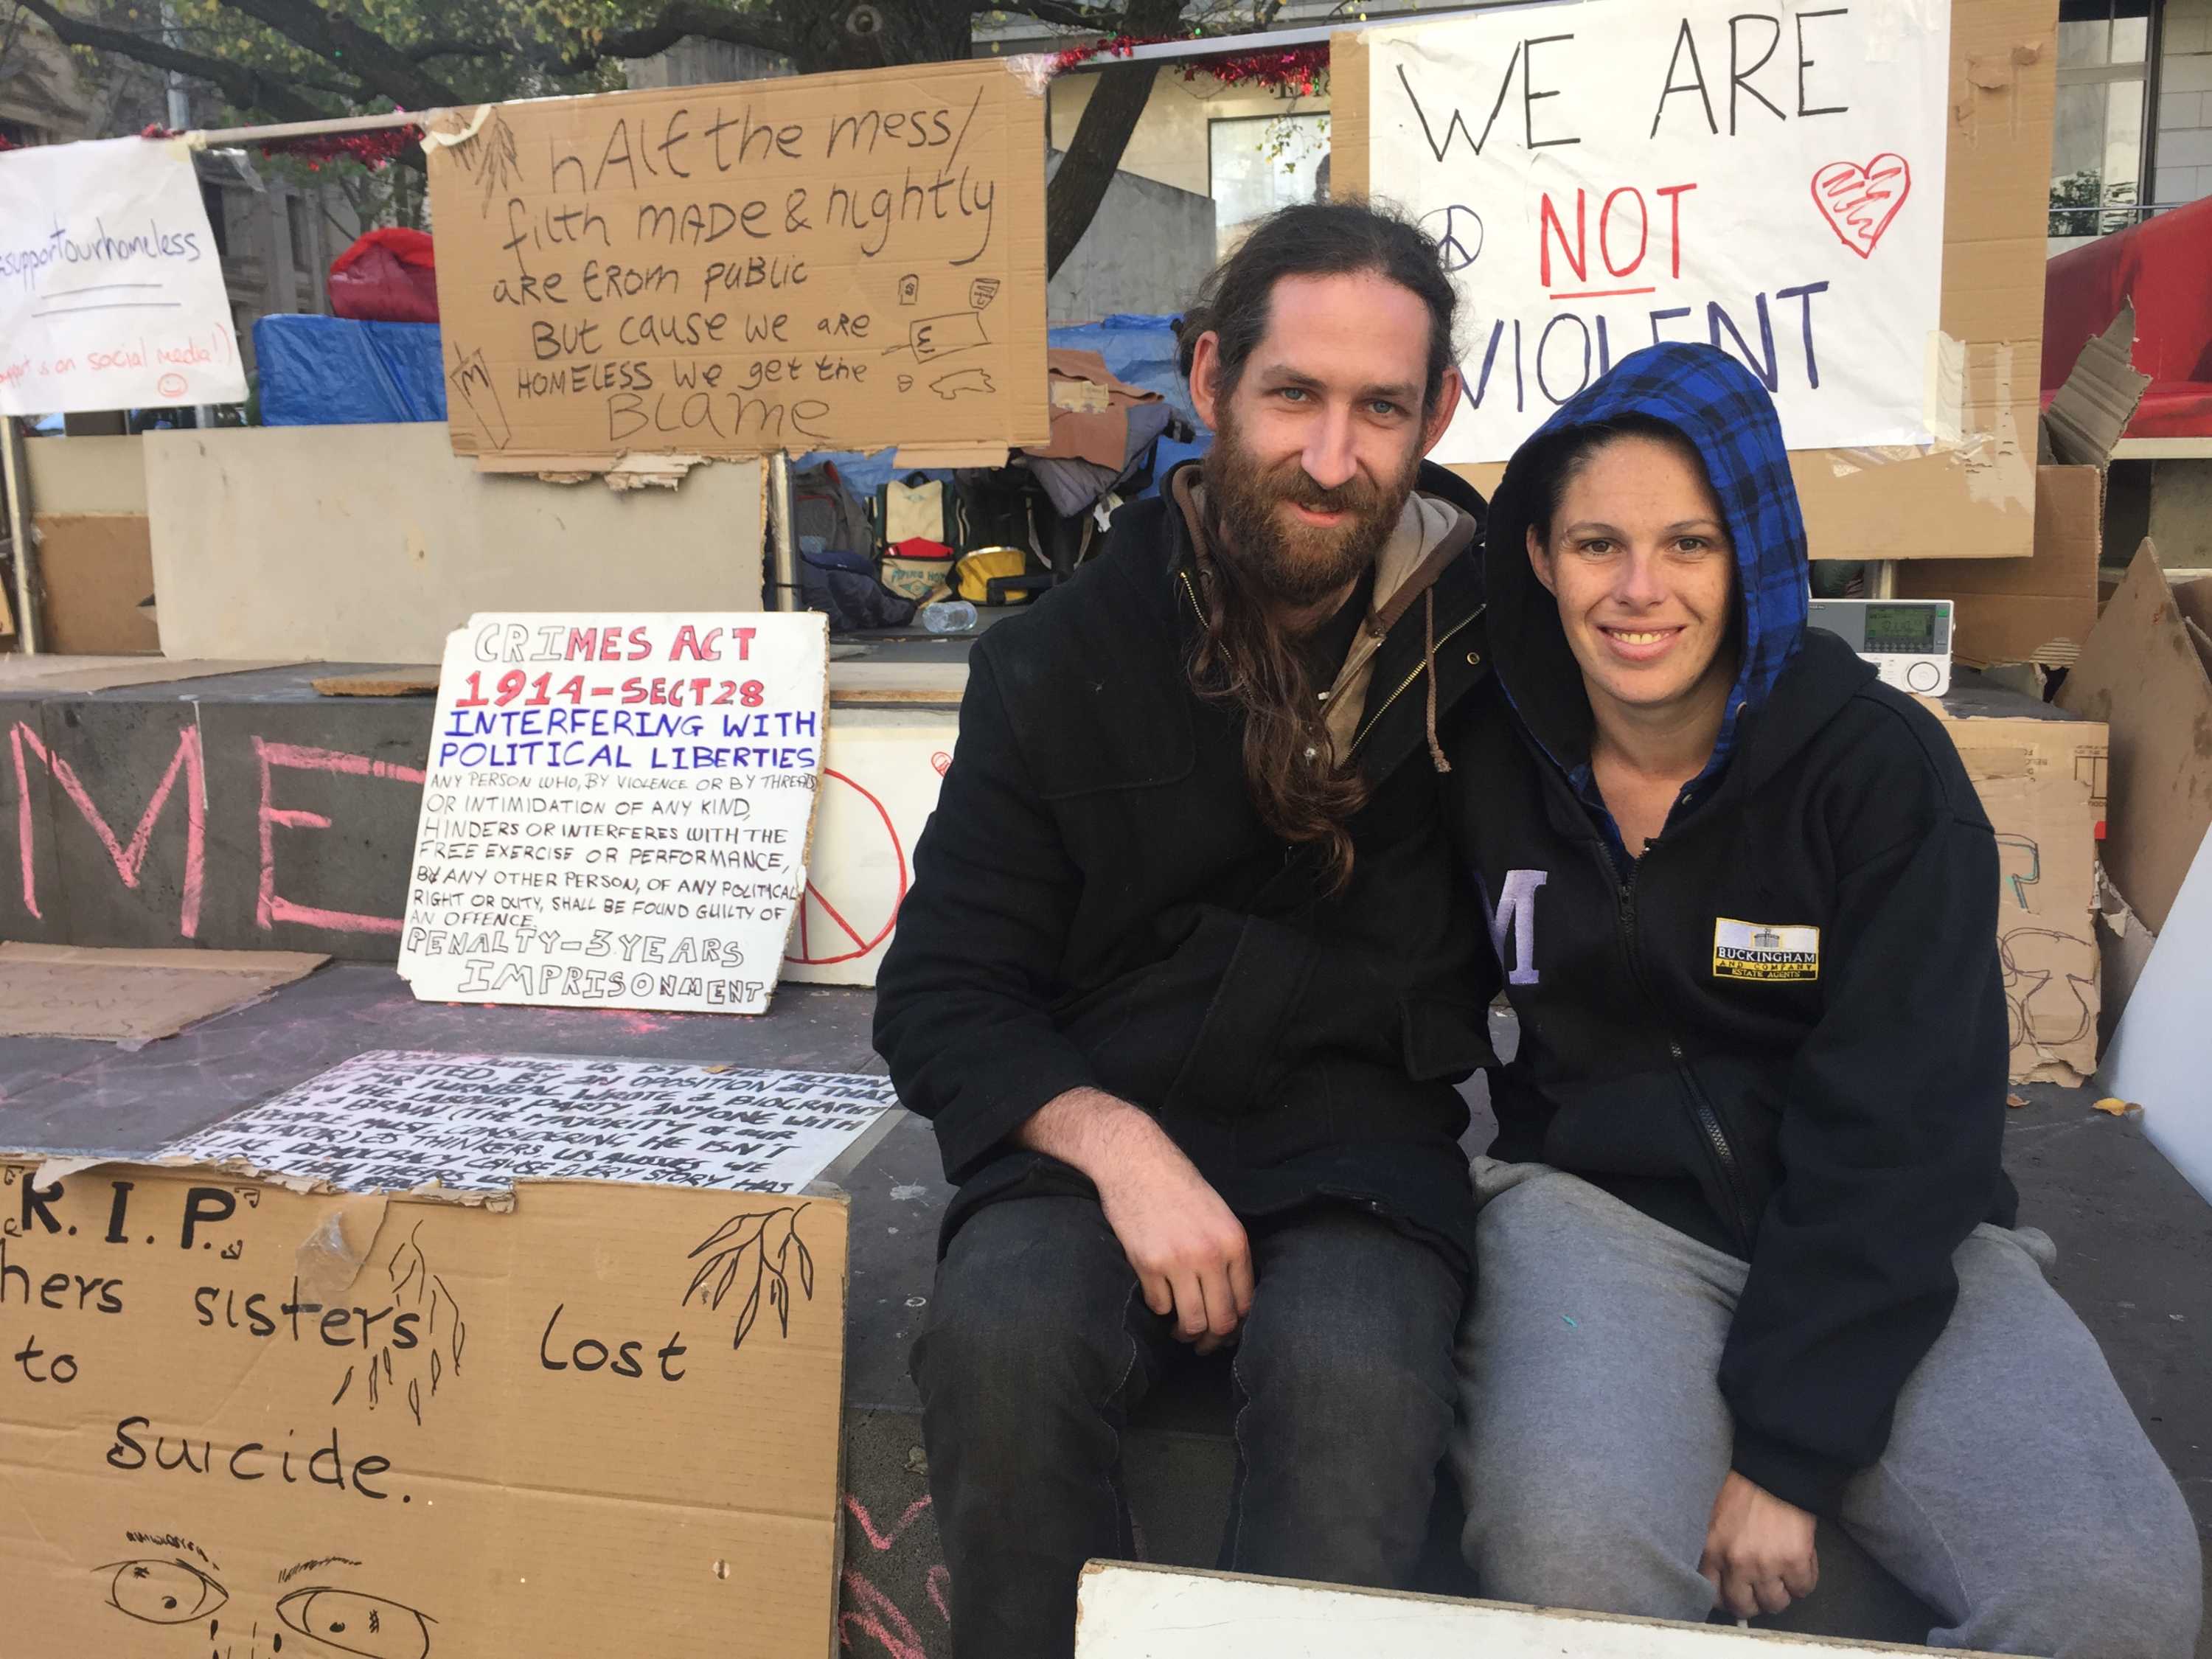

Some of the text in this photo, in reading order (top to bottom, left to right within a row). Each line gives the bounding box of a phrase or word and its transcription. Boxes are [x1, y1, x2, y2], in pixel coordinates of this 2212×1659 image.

[1397, 7, 1848, 161] WE ARE
[705, 104, 802, 171] the
[785, 189, 812, 232] &
[1541, 182, 1697, 287] NOT
[0, 212, 201, 293] supportourhomeless
[87, 335, 147, 371] social
[532, 318, 603, 360] But
[619, 312, 727, 346] cause
[1461, 281, 1829, 412] VIONT
[518, 361, 653, 399] HOMELESS
[737, 357, 802, 391] get
[474, 623, 757, 663] CRIMES ACT
[444, 709, 817, 738] INTERFERING WITH
[439, 740, 816, 769] POLITICAL LIBERTIES
[430, 773, 463, 789] ANY
[470, 771, 532, 788] PERSON
[538, 775, 582, 791] WHO,
[585, 773, 610, 790] BY
[617, 775, 688, 791] VIOLENCE
[696, 777, 723, 791] OR
[730, 774, 756, 790] BY
[426, 793, 751, 821] OR INTIMIDATION OF ANY KIND,
[423, 816, 788, 844] HINDERS OR INTERFERES WITH THE
[419, 840, 790, 874] FREE EXERCISE OR PERFORMANCE,
[443, 866, 487, 886] ANY
[494, 871, 557, 887] OTHER
[565, 871, 640, 894] PERSON,
[647, 878, 672, 891] OF
[678, 879, 717, 897] ANY
[723, 880, 798, 900] POLITICAL
[410, 909, 435, 925] AN
[413, 889, 787, 921] RIGHT OR DUTY, SHALL BE FOUND GUILTY OF
[1718, 947, 1815, 963] BUCKINGHAM
[458, 959, 764, 1004] IMPRISONMENT
[1732, 967, 1801, 978] ESTATE AGENTS
[509, 1071, 566, 1084] BY
[629, 1077, 780, 1093] OPOSITION
[585, 1063, 619, 1073] US
[638, 1065, 691, 1075] BY
[776, 1074, 894, 1088] FICTION
[347, 1085, 406, 1097] THE
[782, 1116, 866, 1131] WITH
[571, 1088, 681, 1103] WROTE
[723, 1096, 888, 1115] BIOGRAPHY
[434, 1127, 639, 1147] CONSIDERING
[636, 1136, 692, 1150] HE
[521, 1113, 698, 1135] MAJORITY
[271, 1142, 470, 1166] DEMOCRACY
[549, 1164, 646, 1178] EVERY
[641, 1169, 735, 1187] STORY
[731, 1179, 794, 1193] HAS
[552, 1149, 597, 1161] US
[195, 1276, 420, 1349] sisters
[540, 1304, 688, 1382] lost
[14, 1335, 78, 1383] to
[107, 1416, 412, 1505] Suicide.
